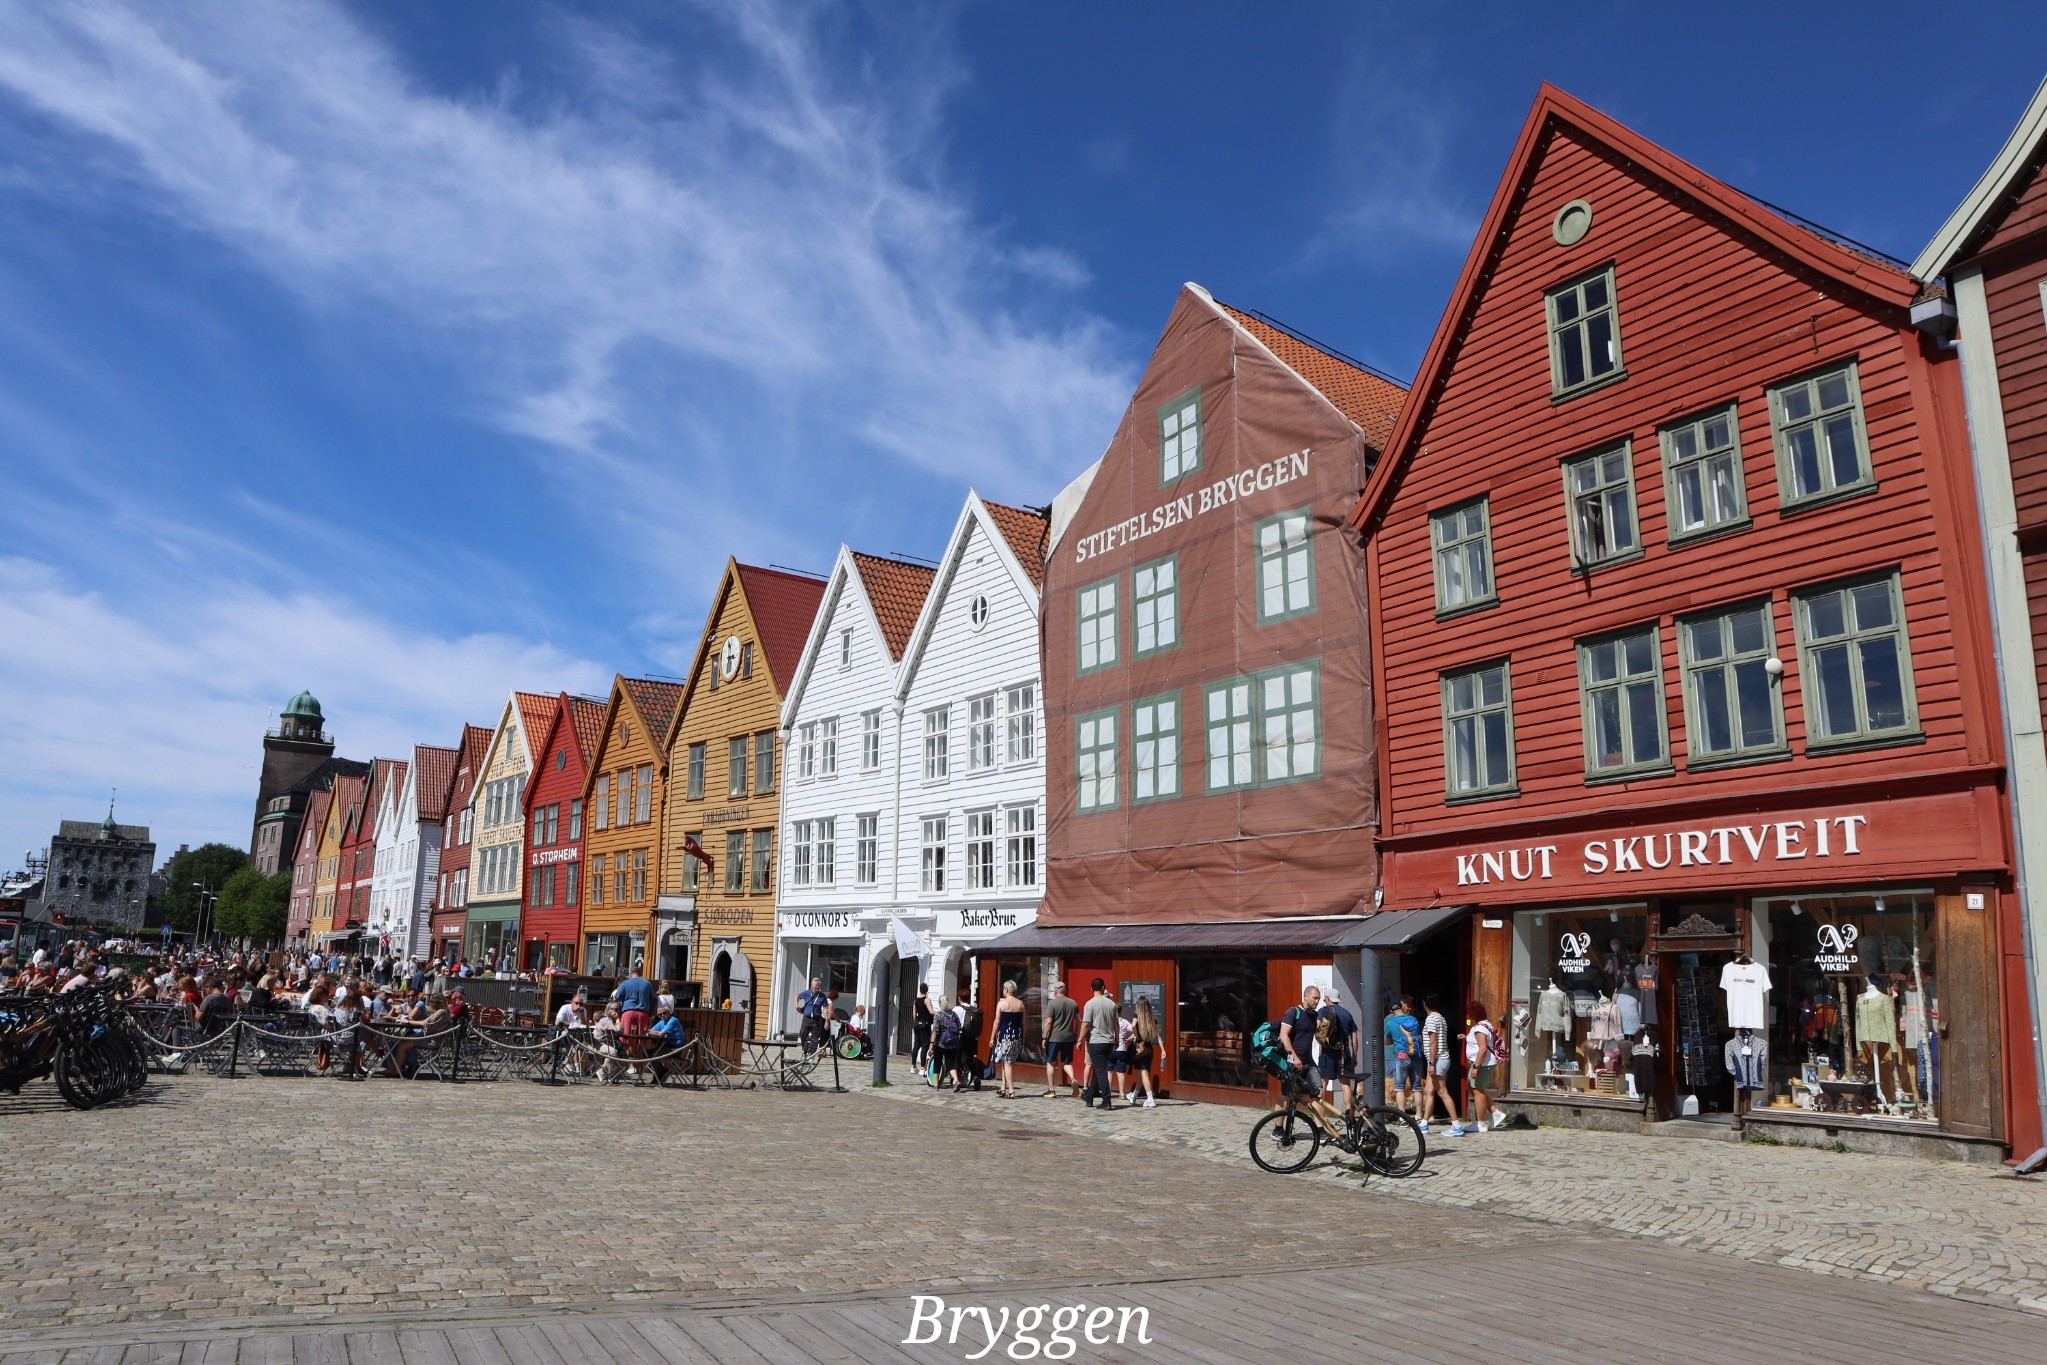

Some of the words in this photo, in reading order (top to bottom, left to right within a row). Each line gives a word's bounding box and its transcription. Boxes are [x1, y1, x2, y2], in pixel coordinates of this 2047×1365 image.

[1076, 494, 1194, 563] STIFTELSEN
[1198, 448, 1311, 515] BRYGGEN
[540, 847, 578, 864] STORHEIM
[1456, 845, 1558, 887] KNUT
[1583, 815, 1867, 875] SKURTVEIT
[704, 907, 754, 924] SJØBODEN
[795, 911, 849, 928] O'CONNOR'S
[960, 907, 1017, 929] BakerBrun
[1814, 955, 1858, 963] AUDHILD
[1820, 963, 1850, 971] VIKEN
